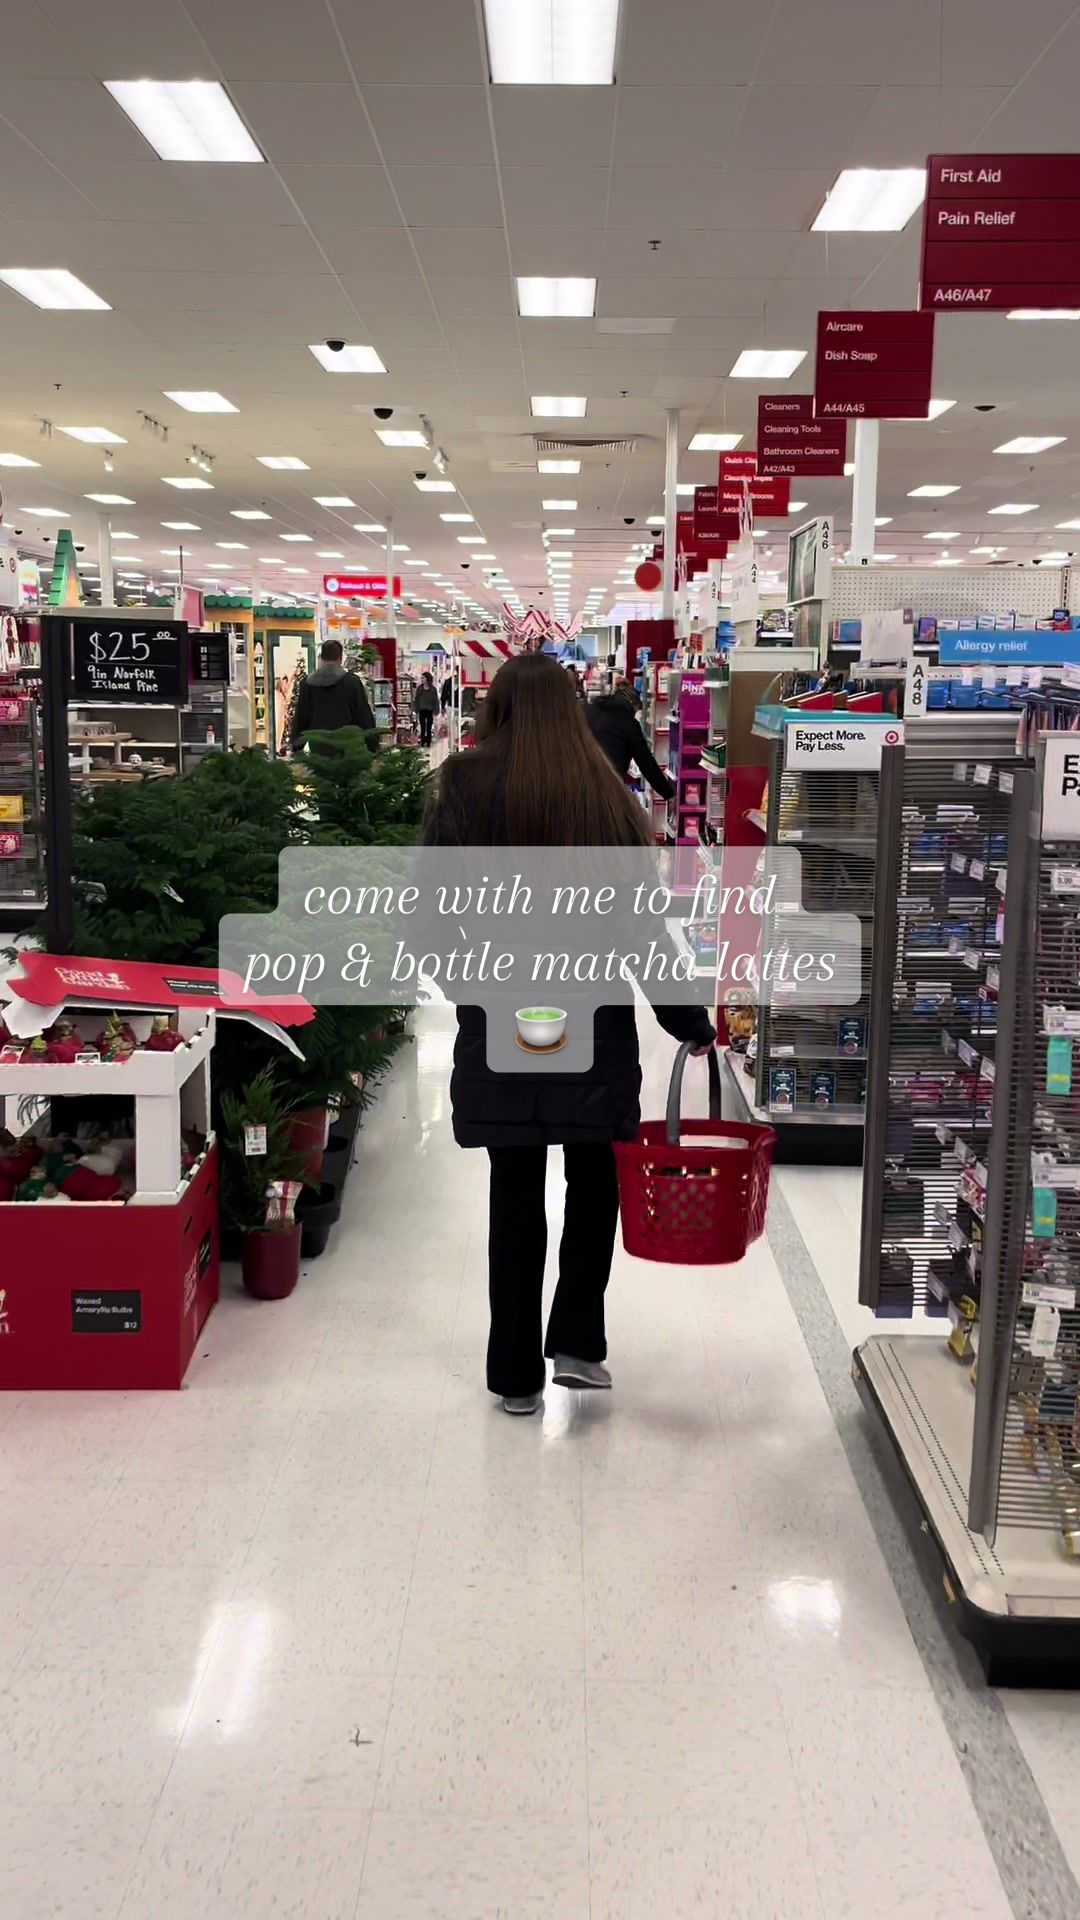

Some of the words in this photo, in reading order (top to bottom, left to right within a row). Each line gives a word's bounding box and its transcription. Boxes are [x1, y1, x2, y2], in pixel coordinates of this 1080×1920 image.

[940, 169, 973, 183] First
[976, 169, 1002, 183] Aid
[938, 211, 970, 225] Pain
[973, 211, 1016, 225] Relief
[933, 288, 992, 303] A46/A47
[826, 321, 863, 332] Aircare
[825, 350, 848, 361] Dish
[850, 350, 878, 362] Soap
[764, 402, 801, 411] Cleaners
[823, 403, 865, 413] A44/A45
[764, 424, 799, 435] Cleaning
[801, 425, 822, 433] Tools
[763, 447, 803, 456] Bathroom
[804, 447, 840, 456] Cleaners
[763, 465, 796, 474] A42/A43
[821, 520, 830, 550] A46
[89, 631, 150, 664] $25
[954, 640, 996, 654] Allergy
[998, 640, 1028, 652] relief
[87, 664, 107, 679] 9in
[91, 680, 131, 690] Island
[136, 680, 159, 693] Pine
[911, 664, 924, 706] A48
[795, 730, 834, 742] Expect
[836, 730, 866, 741] More.
[795, 741, 815, 752] Pay
[817, 741, 846, 751] Less.
[1064, 754, 1080, 774] E
